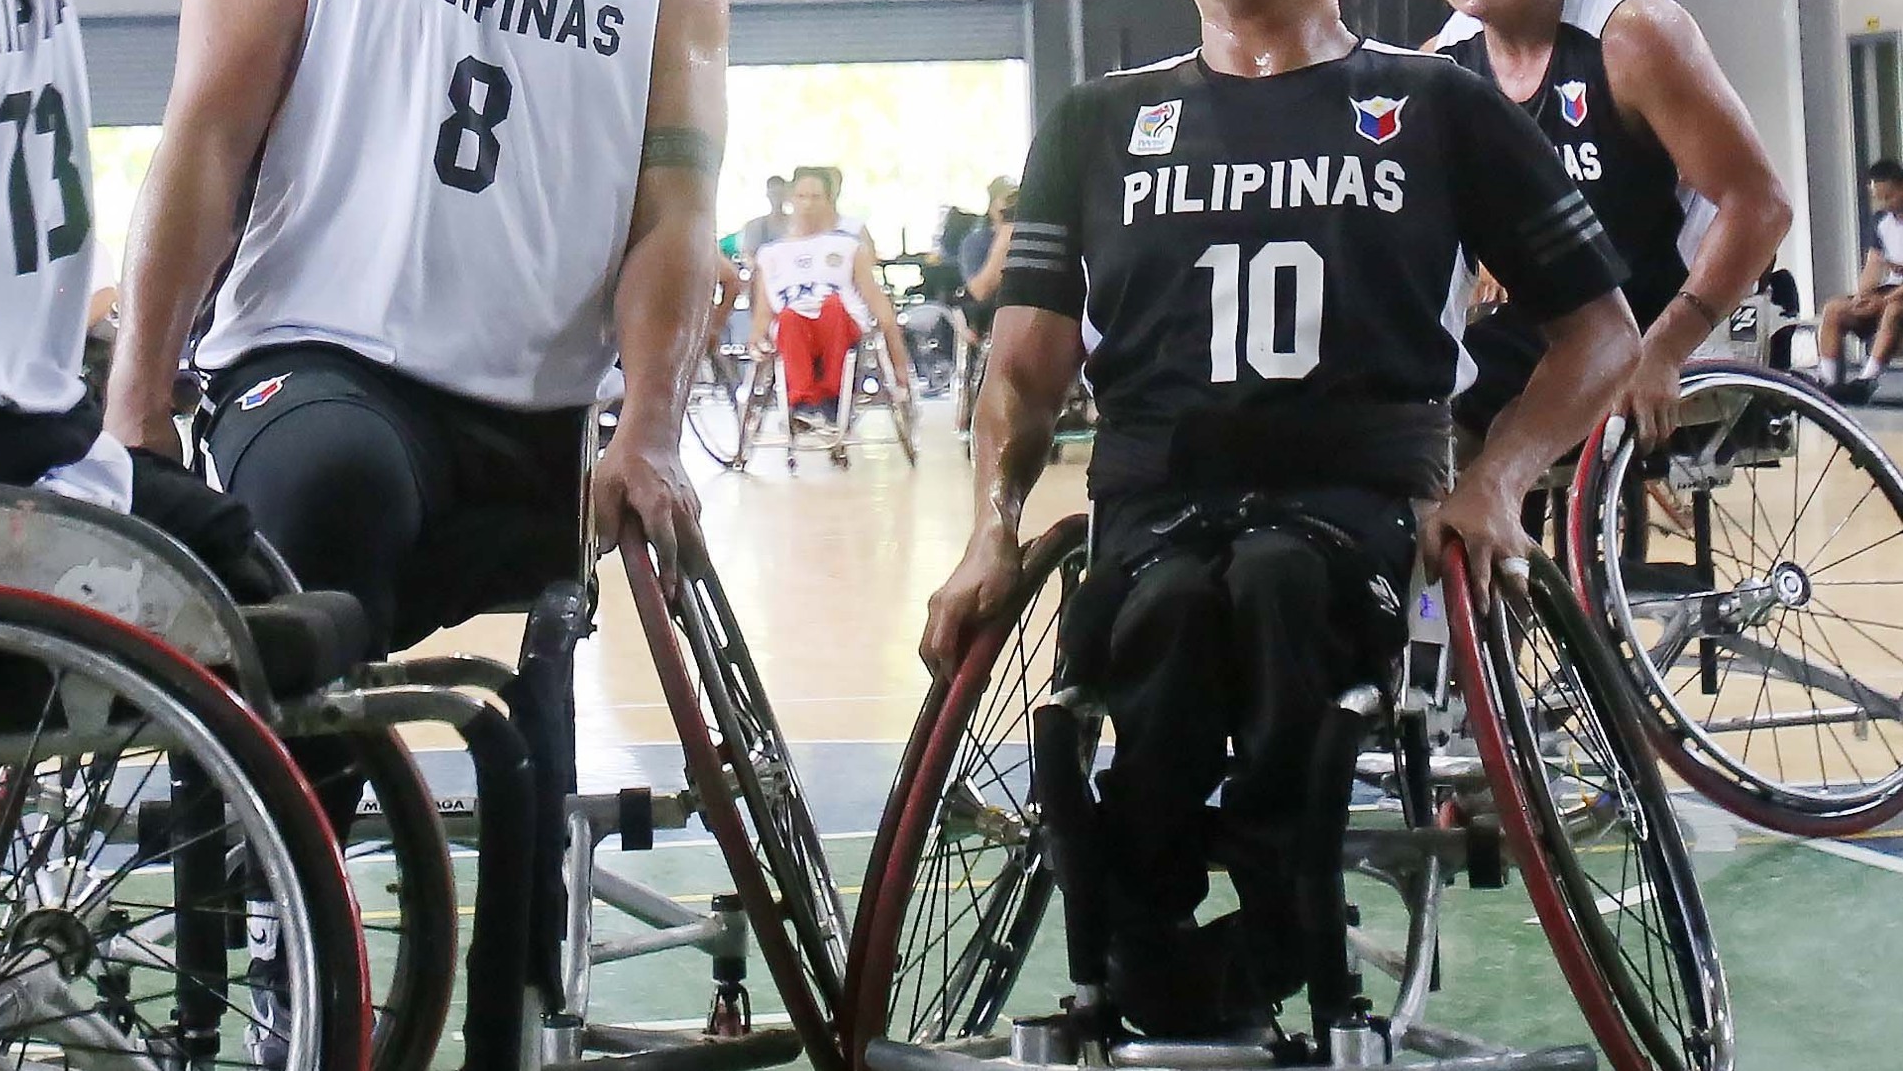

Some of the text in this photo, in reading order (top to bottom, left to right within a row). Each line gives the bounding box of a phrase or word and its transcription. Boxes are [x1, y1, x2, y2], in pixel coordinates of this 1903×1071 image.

[433, 55, 514, 194] 8
[1123, 155, 1407, 227] PILIPINAS
[1194, 240, 1325, 383] 10
